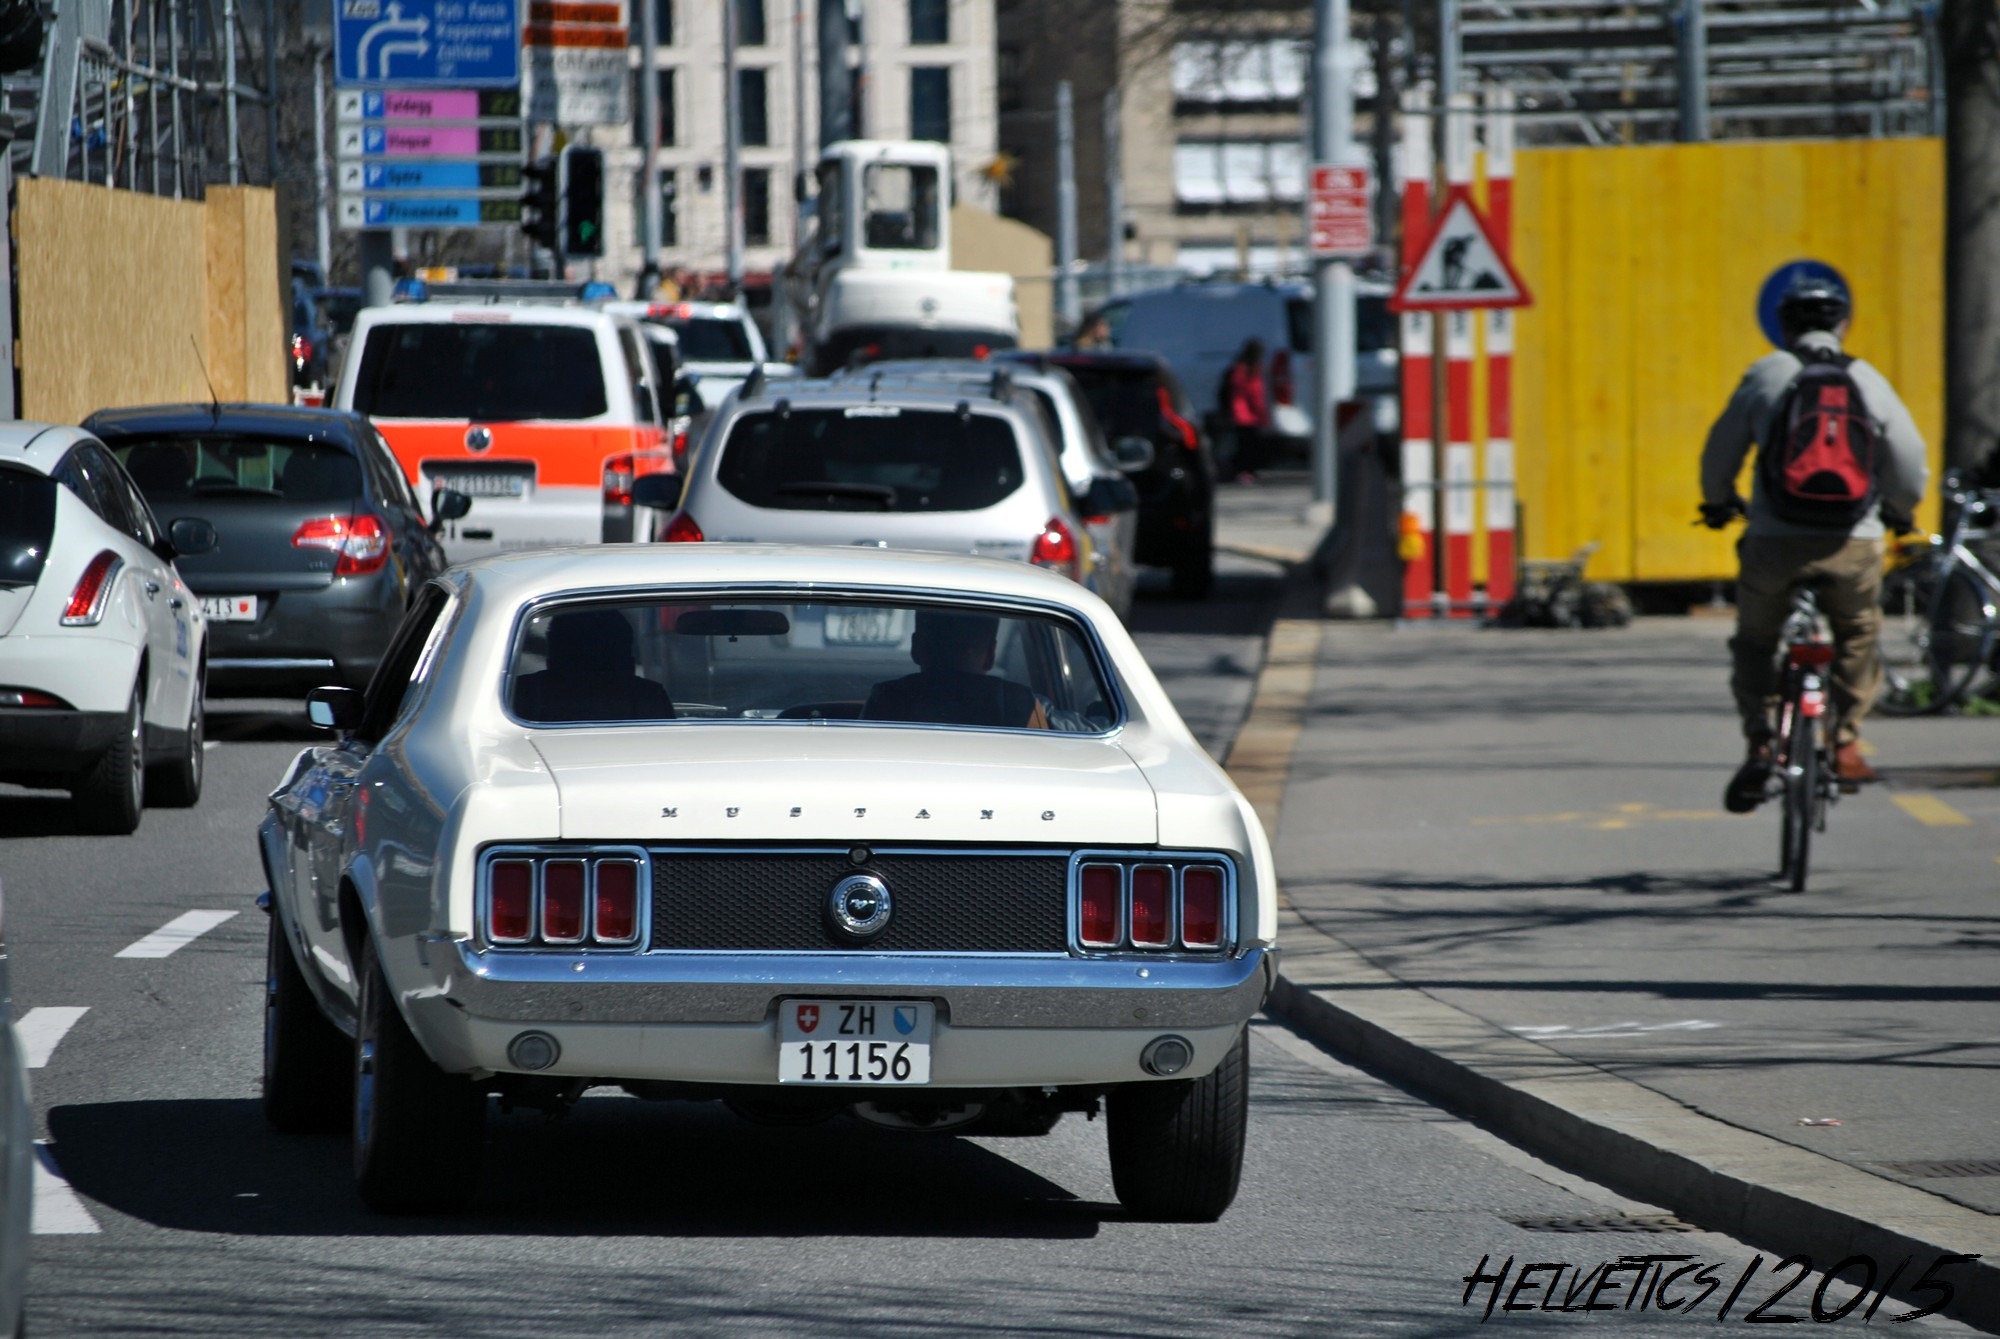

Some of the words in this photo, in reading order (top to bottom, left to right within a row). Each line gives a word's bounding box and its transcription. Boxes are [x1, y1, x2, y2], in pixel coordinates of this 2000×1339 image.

[661, 806, 1056, 822] MUSTANG
[838, 1005, 875, 1034] ZH
[800, 1042, 911, 1081] 11156
